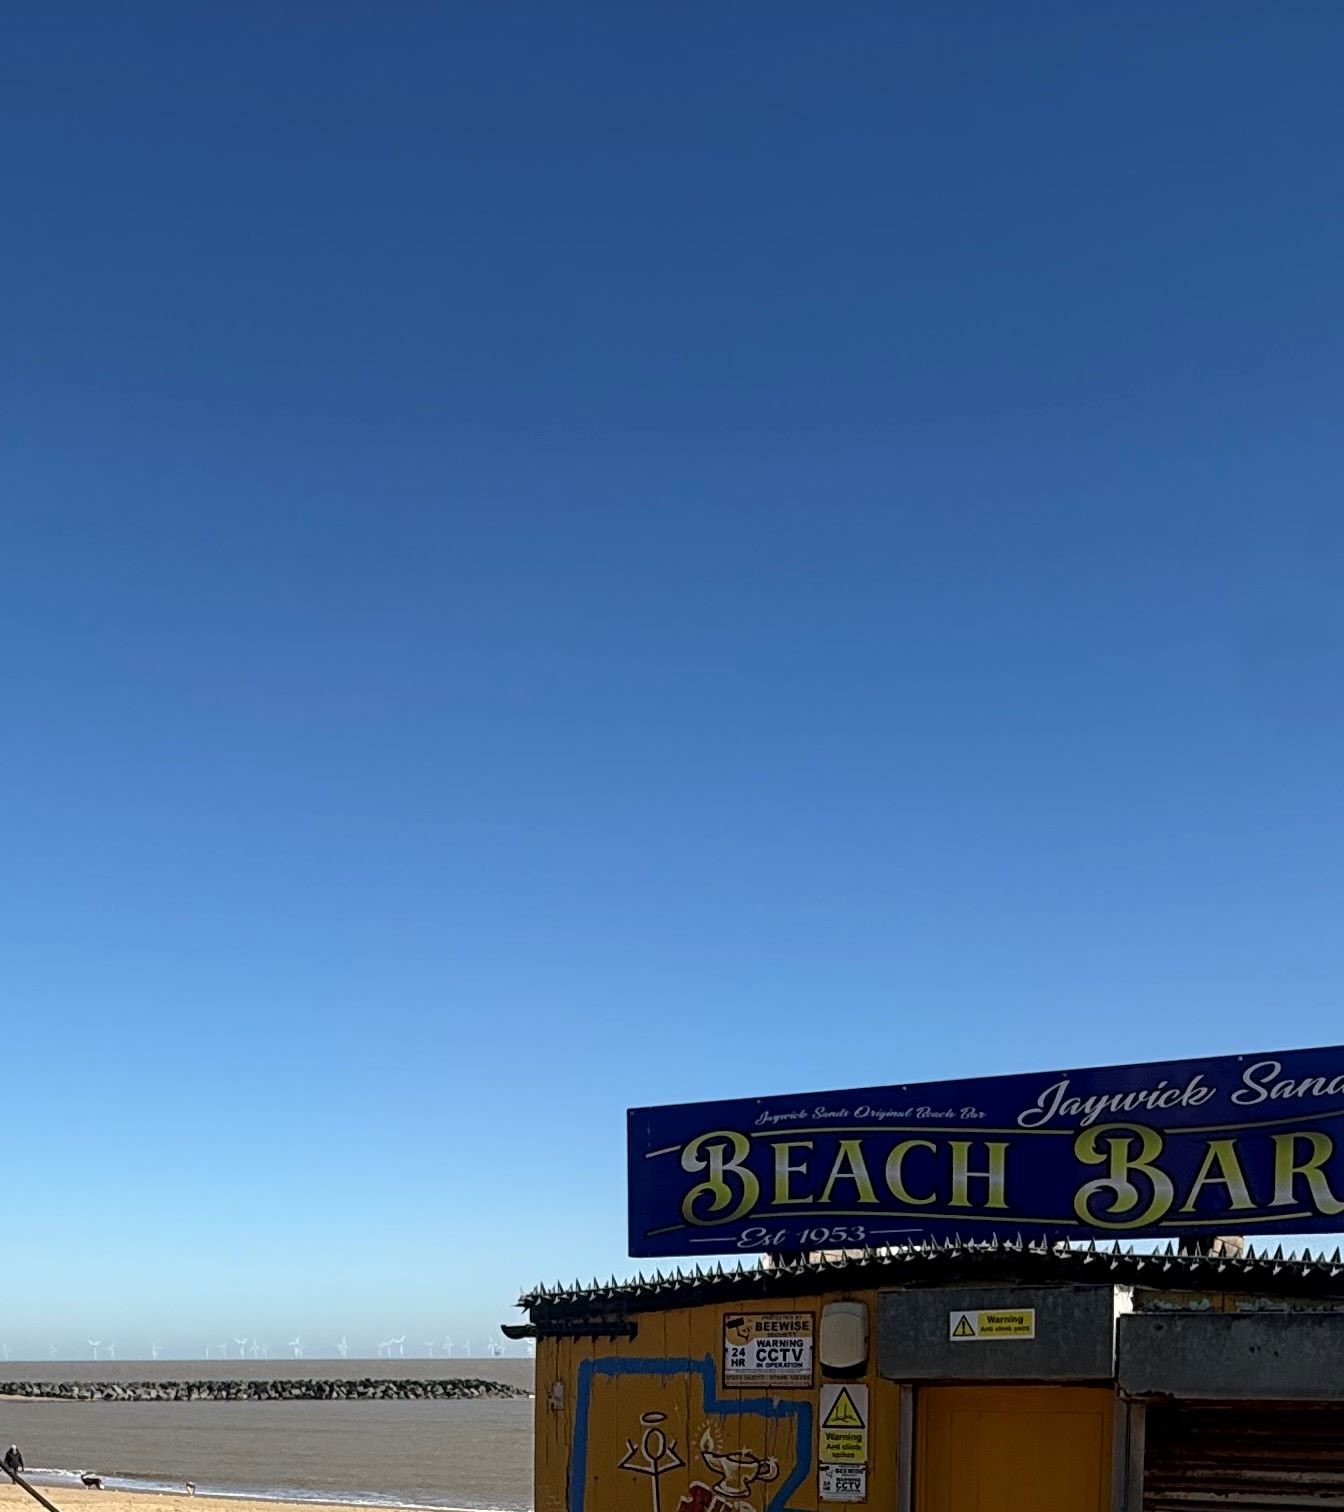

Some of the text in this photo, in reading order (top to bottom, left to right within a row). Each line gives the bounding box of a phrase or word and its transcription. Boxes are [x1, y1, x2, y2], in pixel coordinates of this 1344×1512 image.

[1017, 1074, 1216, 1128] Jaywick
[755, 1105, 987, 1125] Jaywick Sands Original Beach Bar
[681, 1130, 1010, 1226] BEACH
[737, 1225, 866, 1248] Est 1953
[987, 1314, 1024, 1325] Warning
[755, 1321, 811, 1332] BEEWISE
[757, 1339, 804, 1348] WARNING
[732, 1347, 746, 1358] 24
[756, 1348, 804, 1362] CCTV
[731, 1358, 746, 1368] HR
